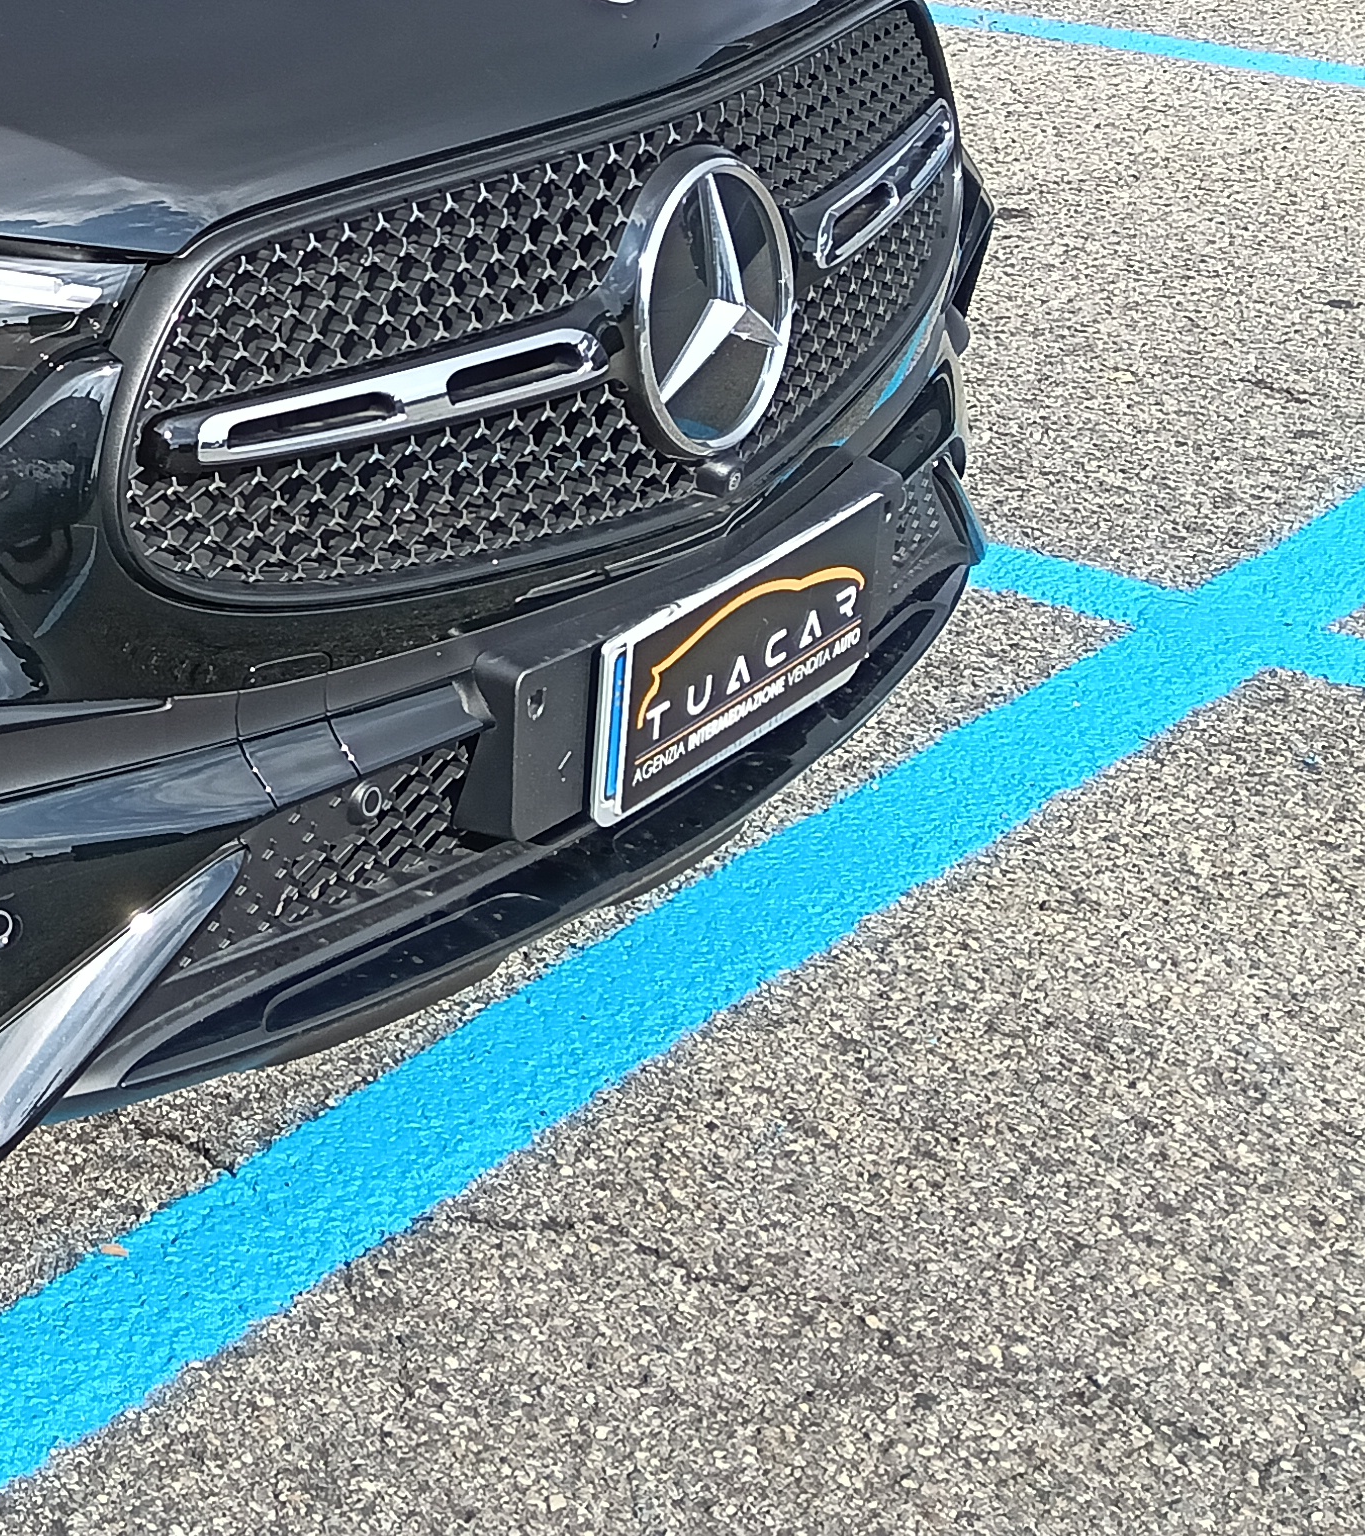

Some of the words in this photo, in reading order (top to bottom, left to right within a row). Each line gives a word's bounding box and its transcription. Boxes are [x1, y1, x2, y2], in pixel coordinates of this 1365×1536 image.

[631, 741, 686, 787] AGENZIA
[687, 675, 786, 751] INTERMEDIAZIONE
[787, 651, 832, 686] VENDITA
[832, 626, 862, 660] AUTO
[645, 584, 858, 741] TUACAR
